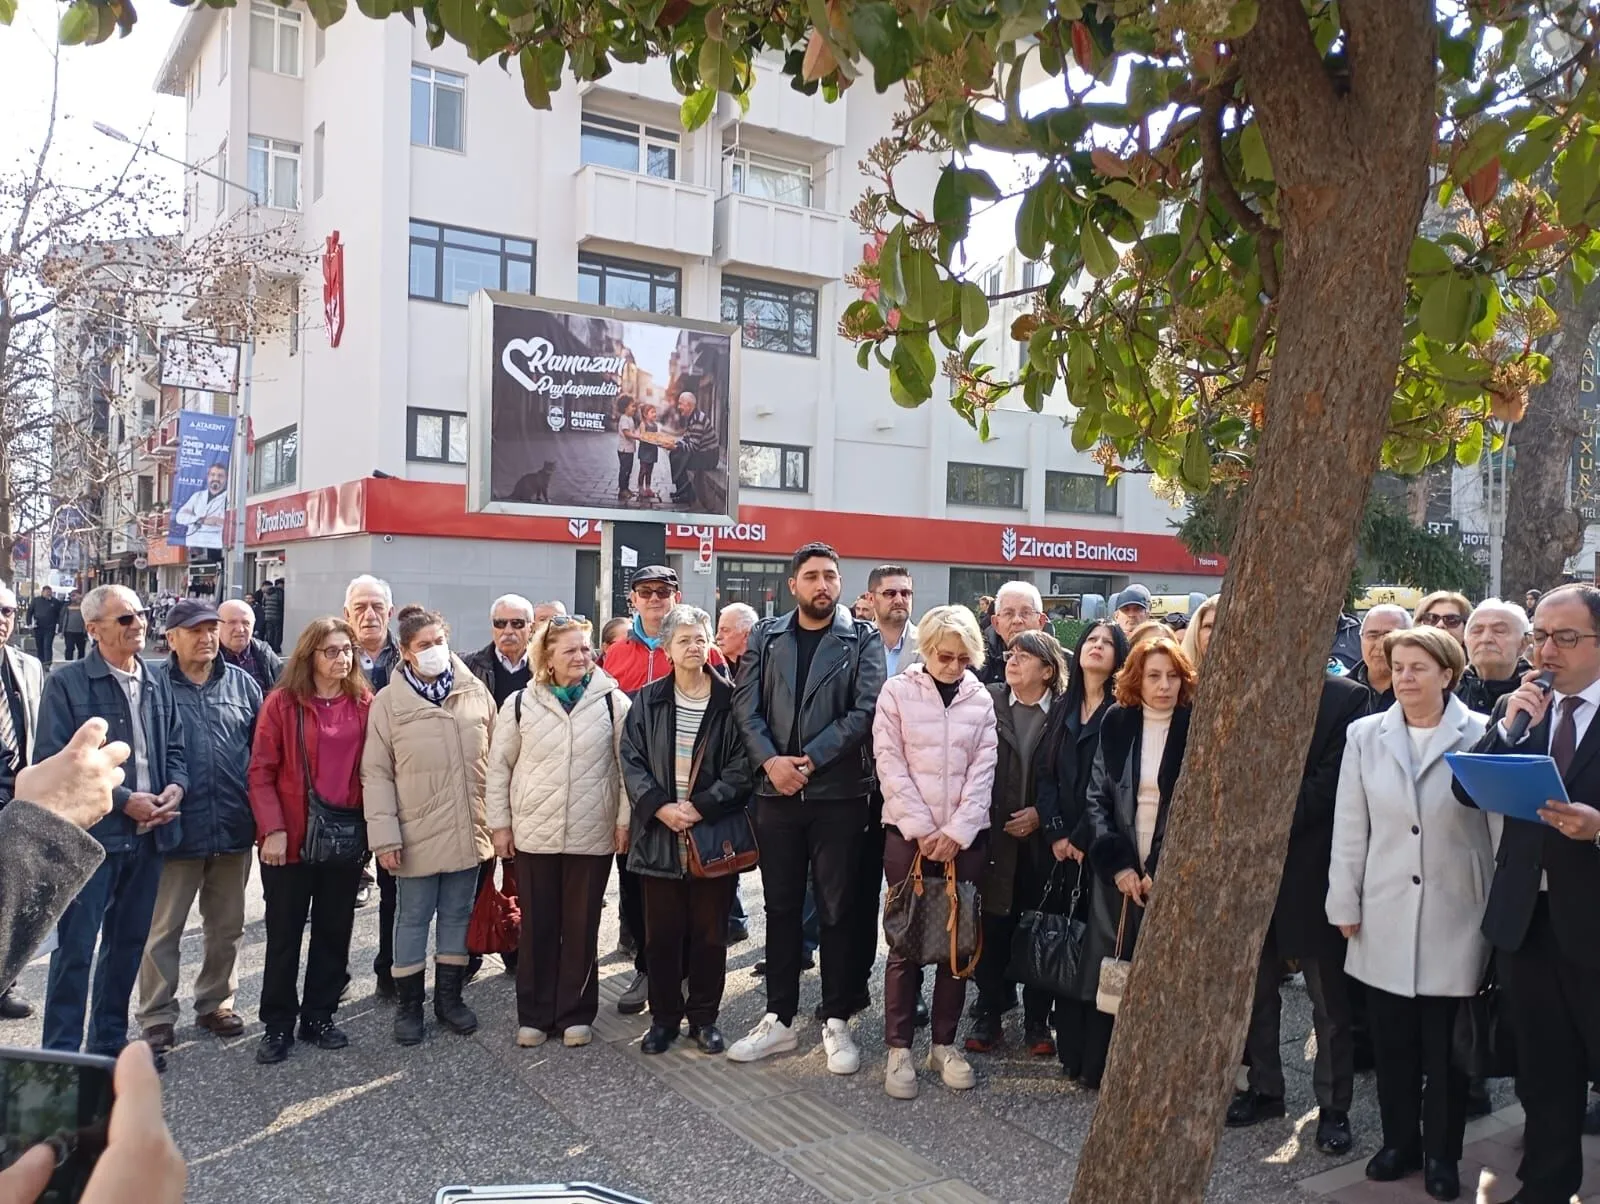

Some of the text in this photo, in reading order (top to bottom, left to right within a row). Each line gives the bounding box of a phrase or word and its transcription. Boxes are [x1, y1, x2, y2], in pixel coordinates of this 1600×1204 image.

[528, 337, 626, 375] Ramazan
[1581, 347, 1595, 393] AND
[537, 375, 621, 399] Paylaşmaktır
[571, 411, 605, 420] MEHMET
[195, 421, 226, 431] ATAKENT
[205, 443, 230, 452] FARUK
[261, 511, 279, 533] Ziraat
[1427, 521, 1453, 535] RT
[1462, 534, 1489, 545] HOTE
[1019, 536, 1138, 562] Ziraat Bankası
[1198, 557, 1218, 566] Yalova
